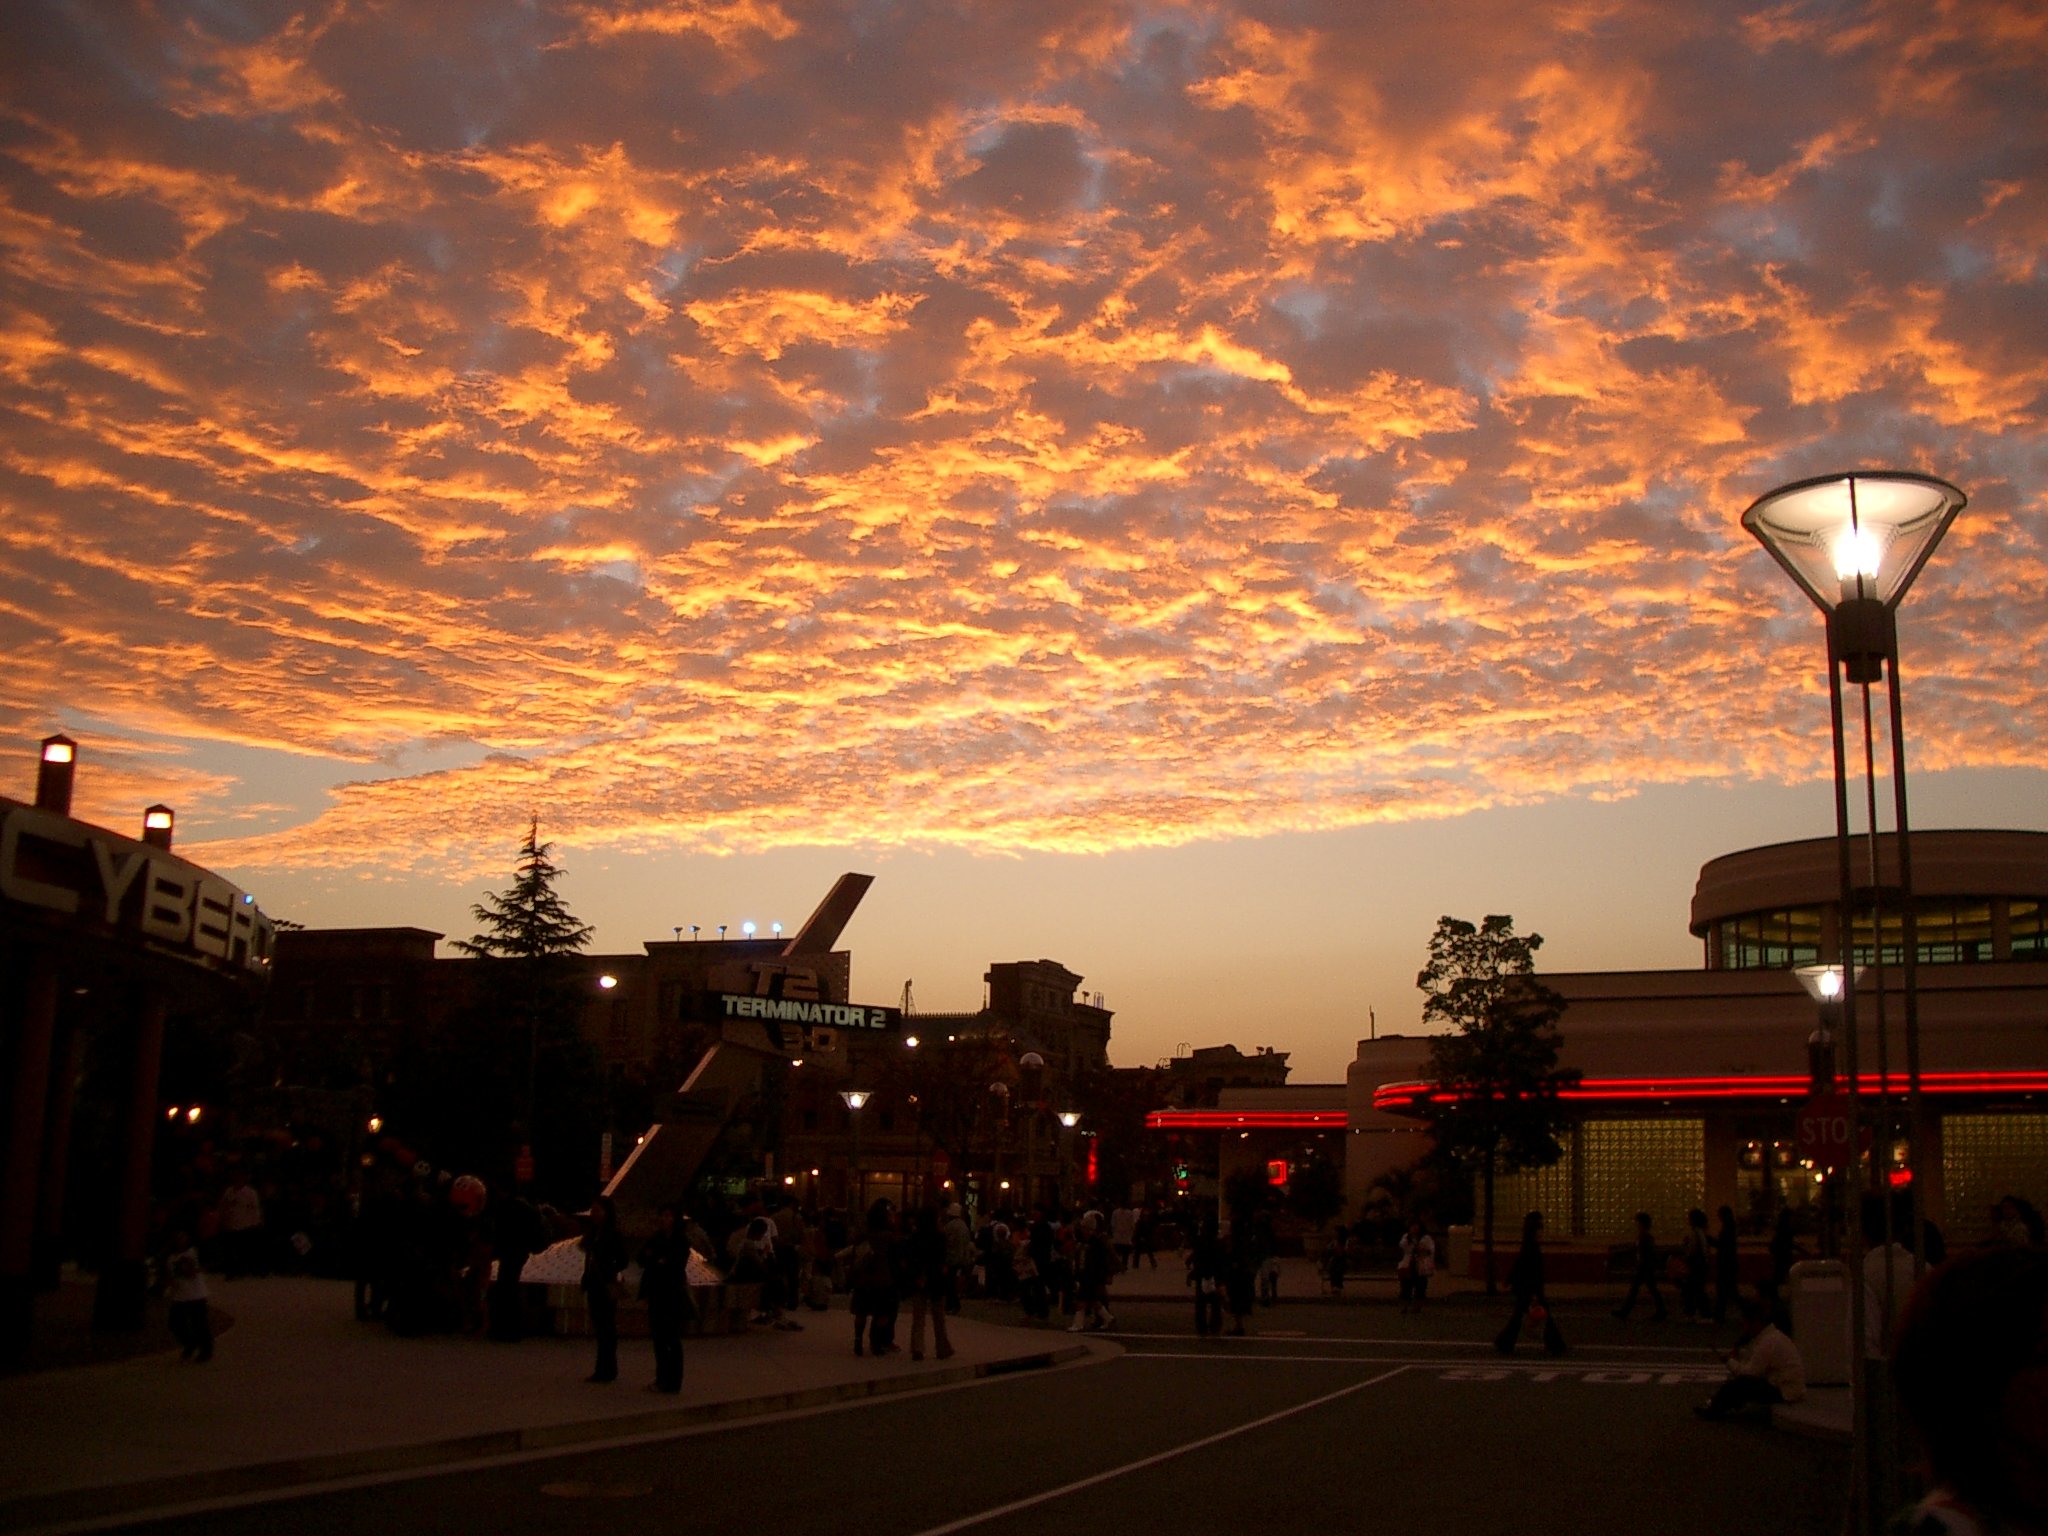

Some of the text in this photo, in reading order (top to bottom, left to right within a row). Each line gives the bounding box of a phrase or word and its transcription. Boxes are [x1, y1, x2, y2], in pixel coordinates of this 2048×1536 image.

[751, 962, 820, 1000] T2
[721, 994, 887, 1030] TERMINATOR 2
[1801, 1116, 1850, 1144] STO
